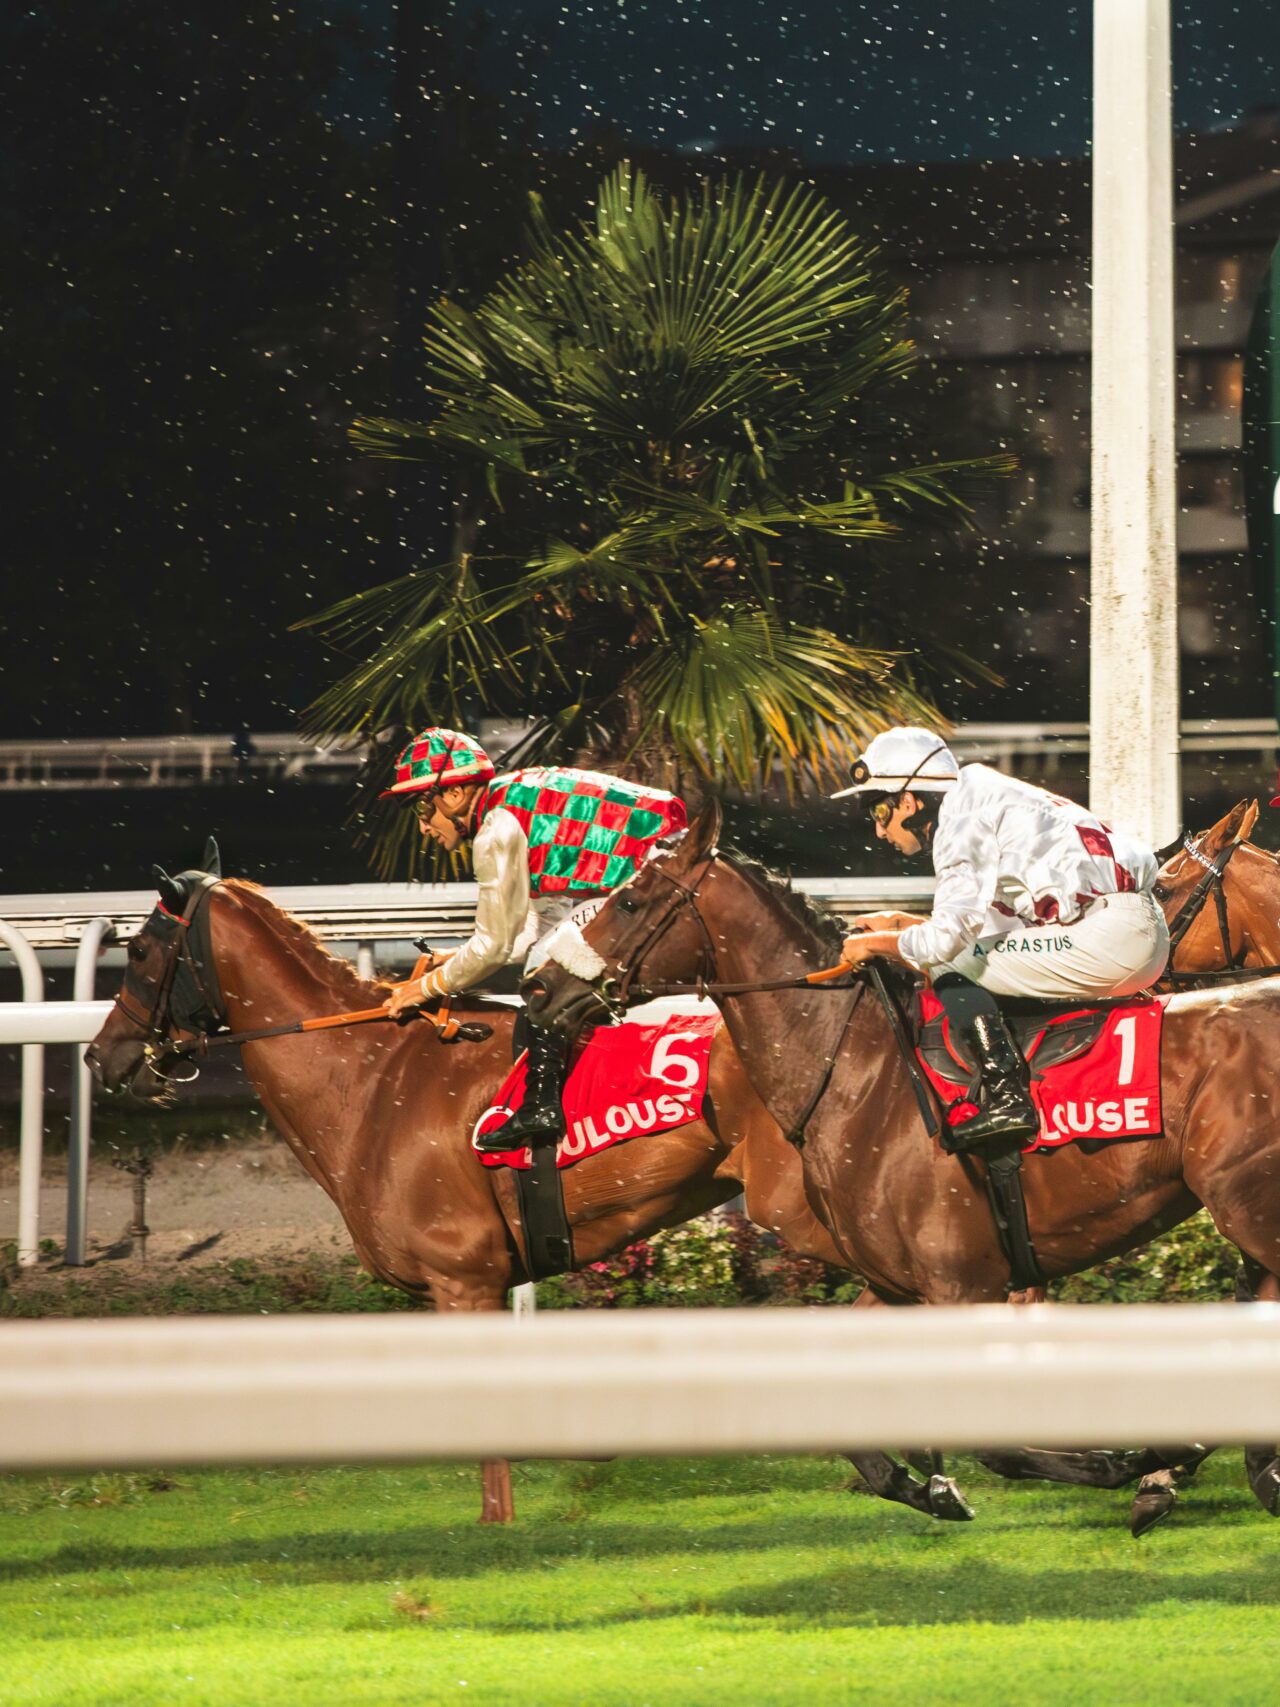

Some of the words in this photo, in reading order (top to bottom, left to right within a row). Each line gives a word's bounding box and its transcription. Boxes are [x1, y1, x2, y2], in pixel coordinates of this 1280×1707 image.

[994, 935, 1073, 953] CRASTUS
[650, 1031, 700, 1090] 6
[1113, 1016, 1137, 1086] 1
[556, 1093, 697, 1162] ULOUS
